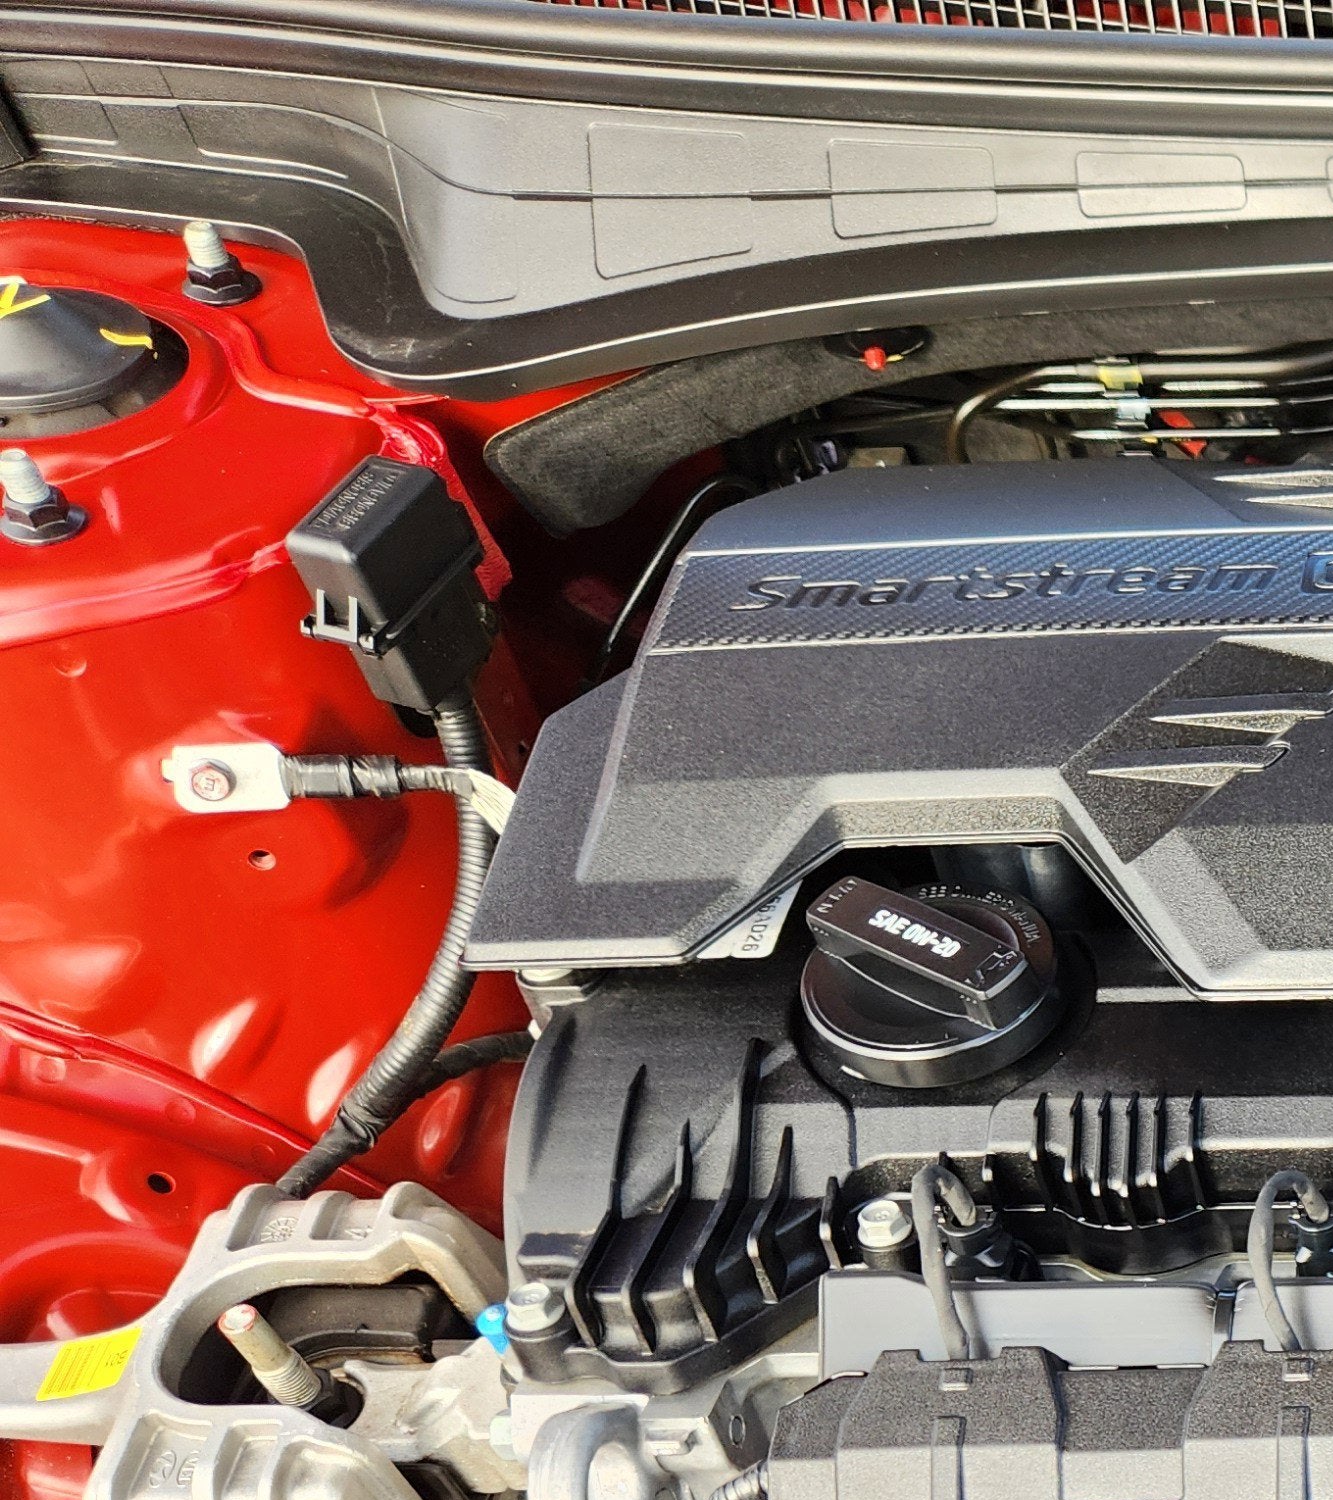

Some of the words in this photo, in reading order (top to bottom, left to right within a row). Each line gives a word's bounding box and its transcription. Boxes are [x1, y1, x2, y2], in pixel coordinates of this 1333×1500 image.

[728, 560, 1281, 612] Smartstream
[868, 909, 910, 935] SAE
[902, 922, 961, 958] 0W-20
